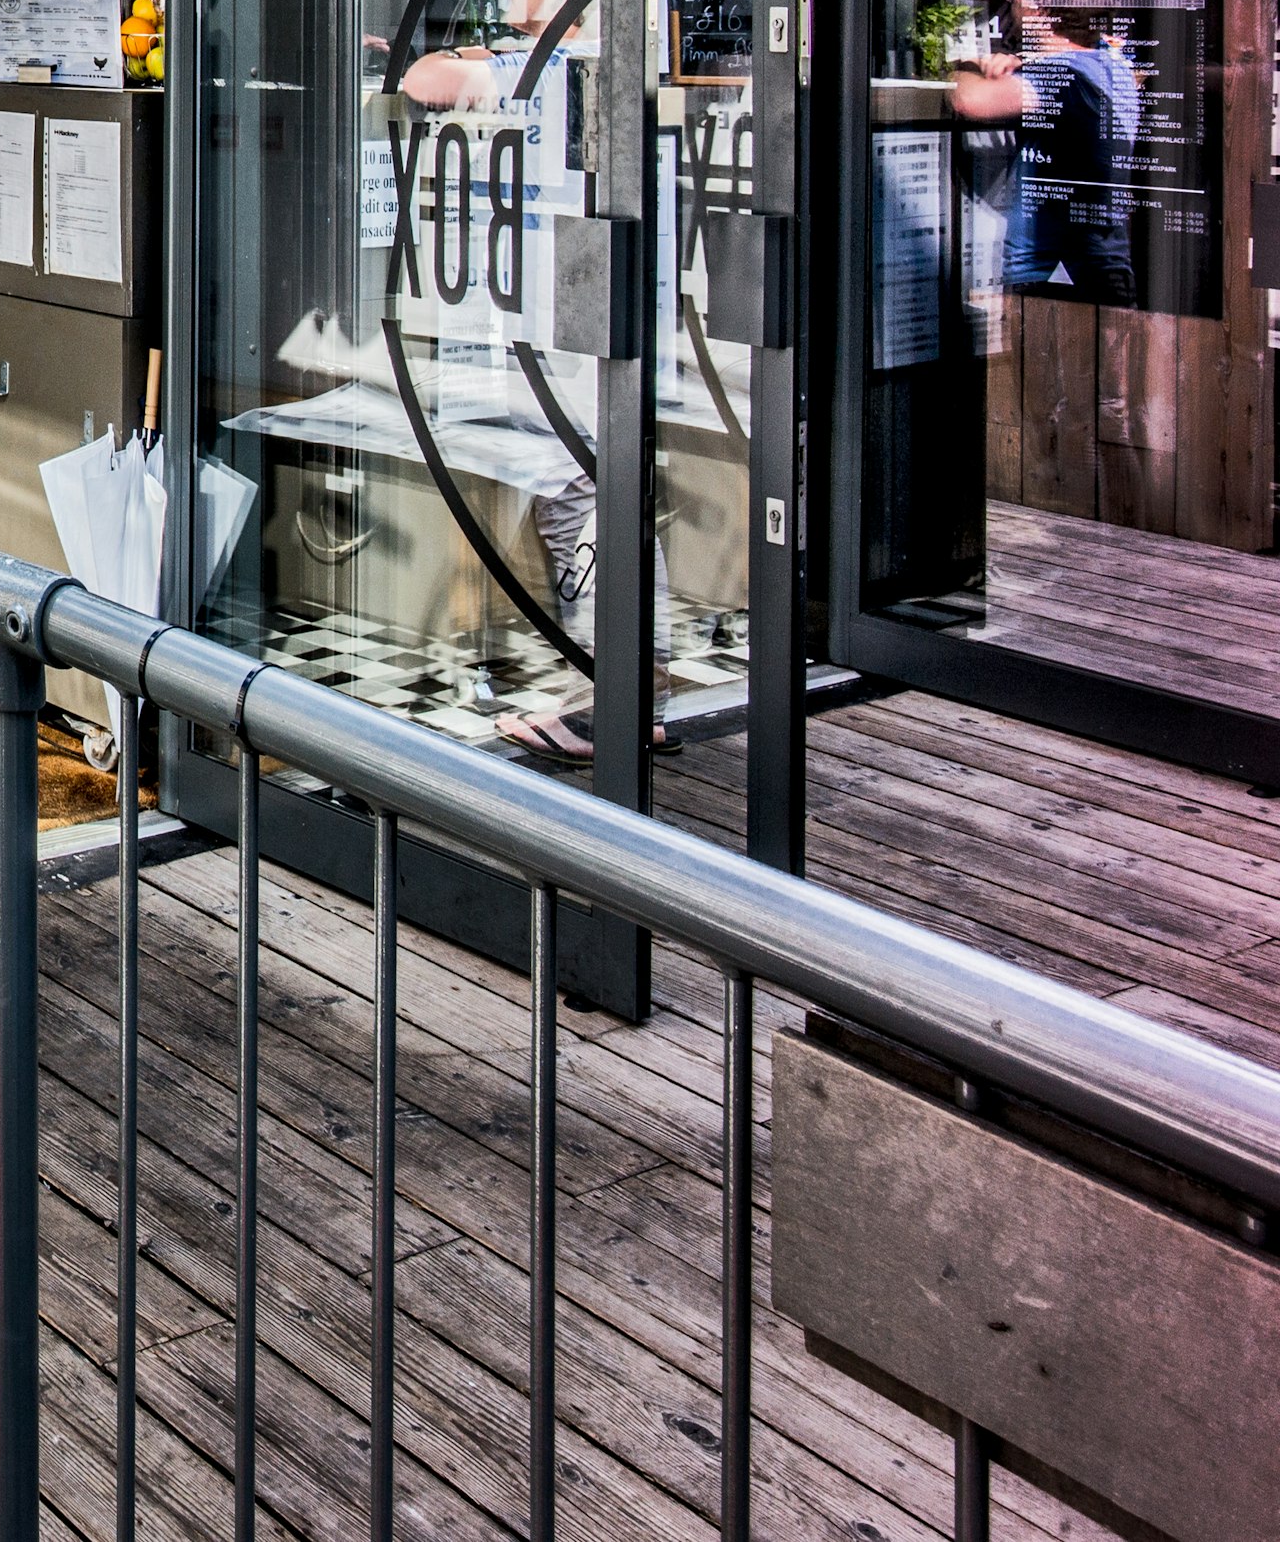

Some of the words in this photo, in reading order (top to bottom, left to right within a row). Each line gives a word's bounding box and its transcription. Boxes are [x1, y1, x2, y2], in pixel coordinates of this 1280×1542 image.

[59, 129, 79, 139] Hackney
[1126, 156, 1151, 164] ACCESS
[1148, 165, 1177, 173] BOXPARK
[1043, 185, 1074, 194] BEVERAGE
[1021, 191, 1048, 199] OPENING
